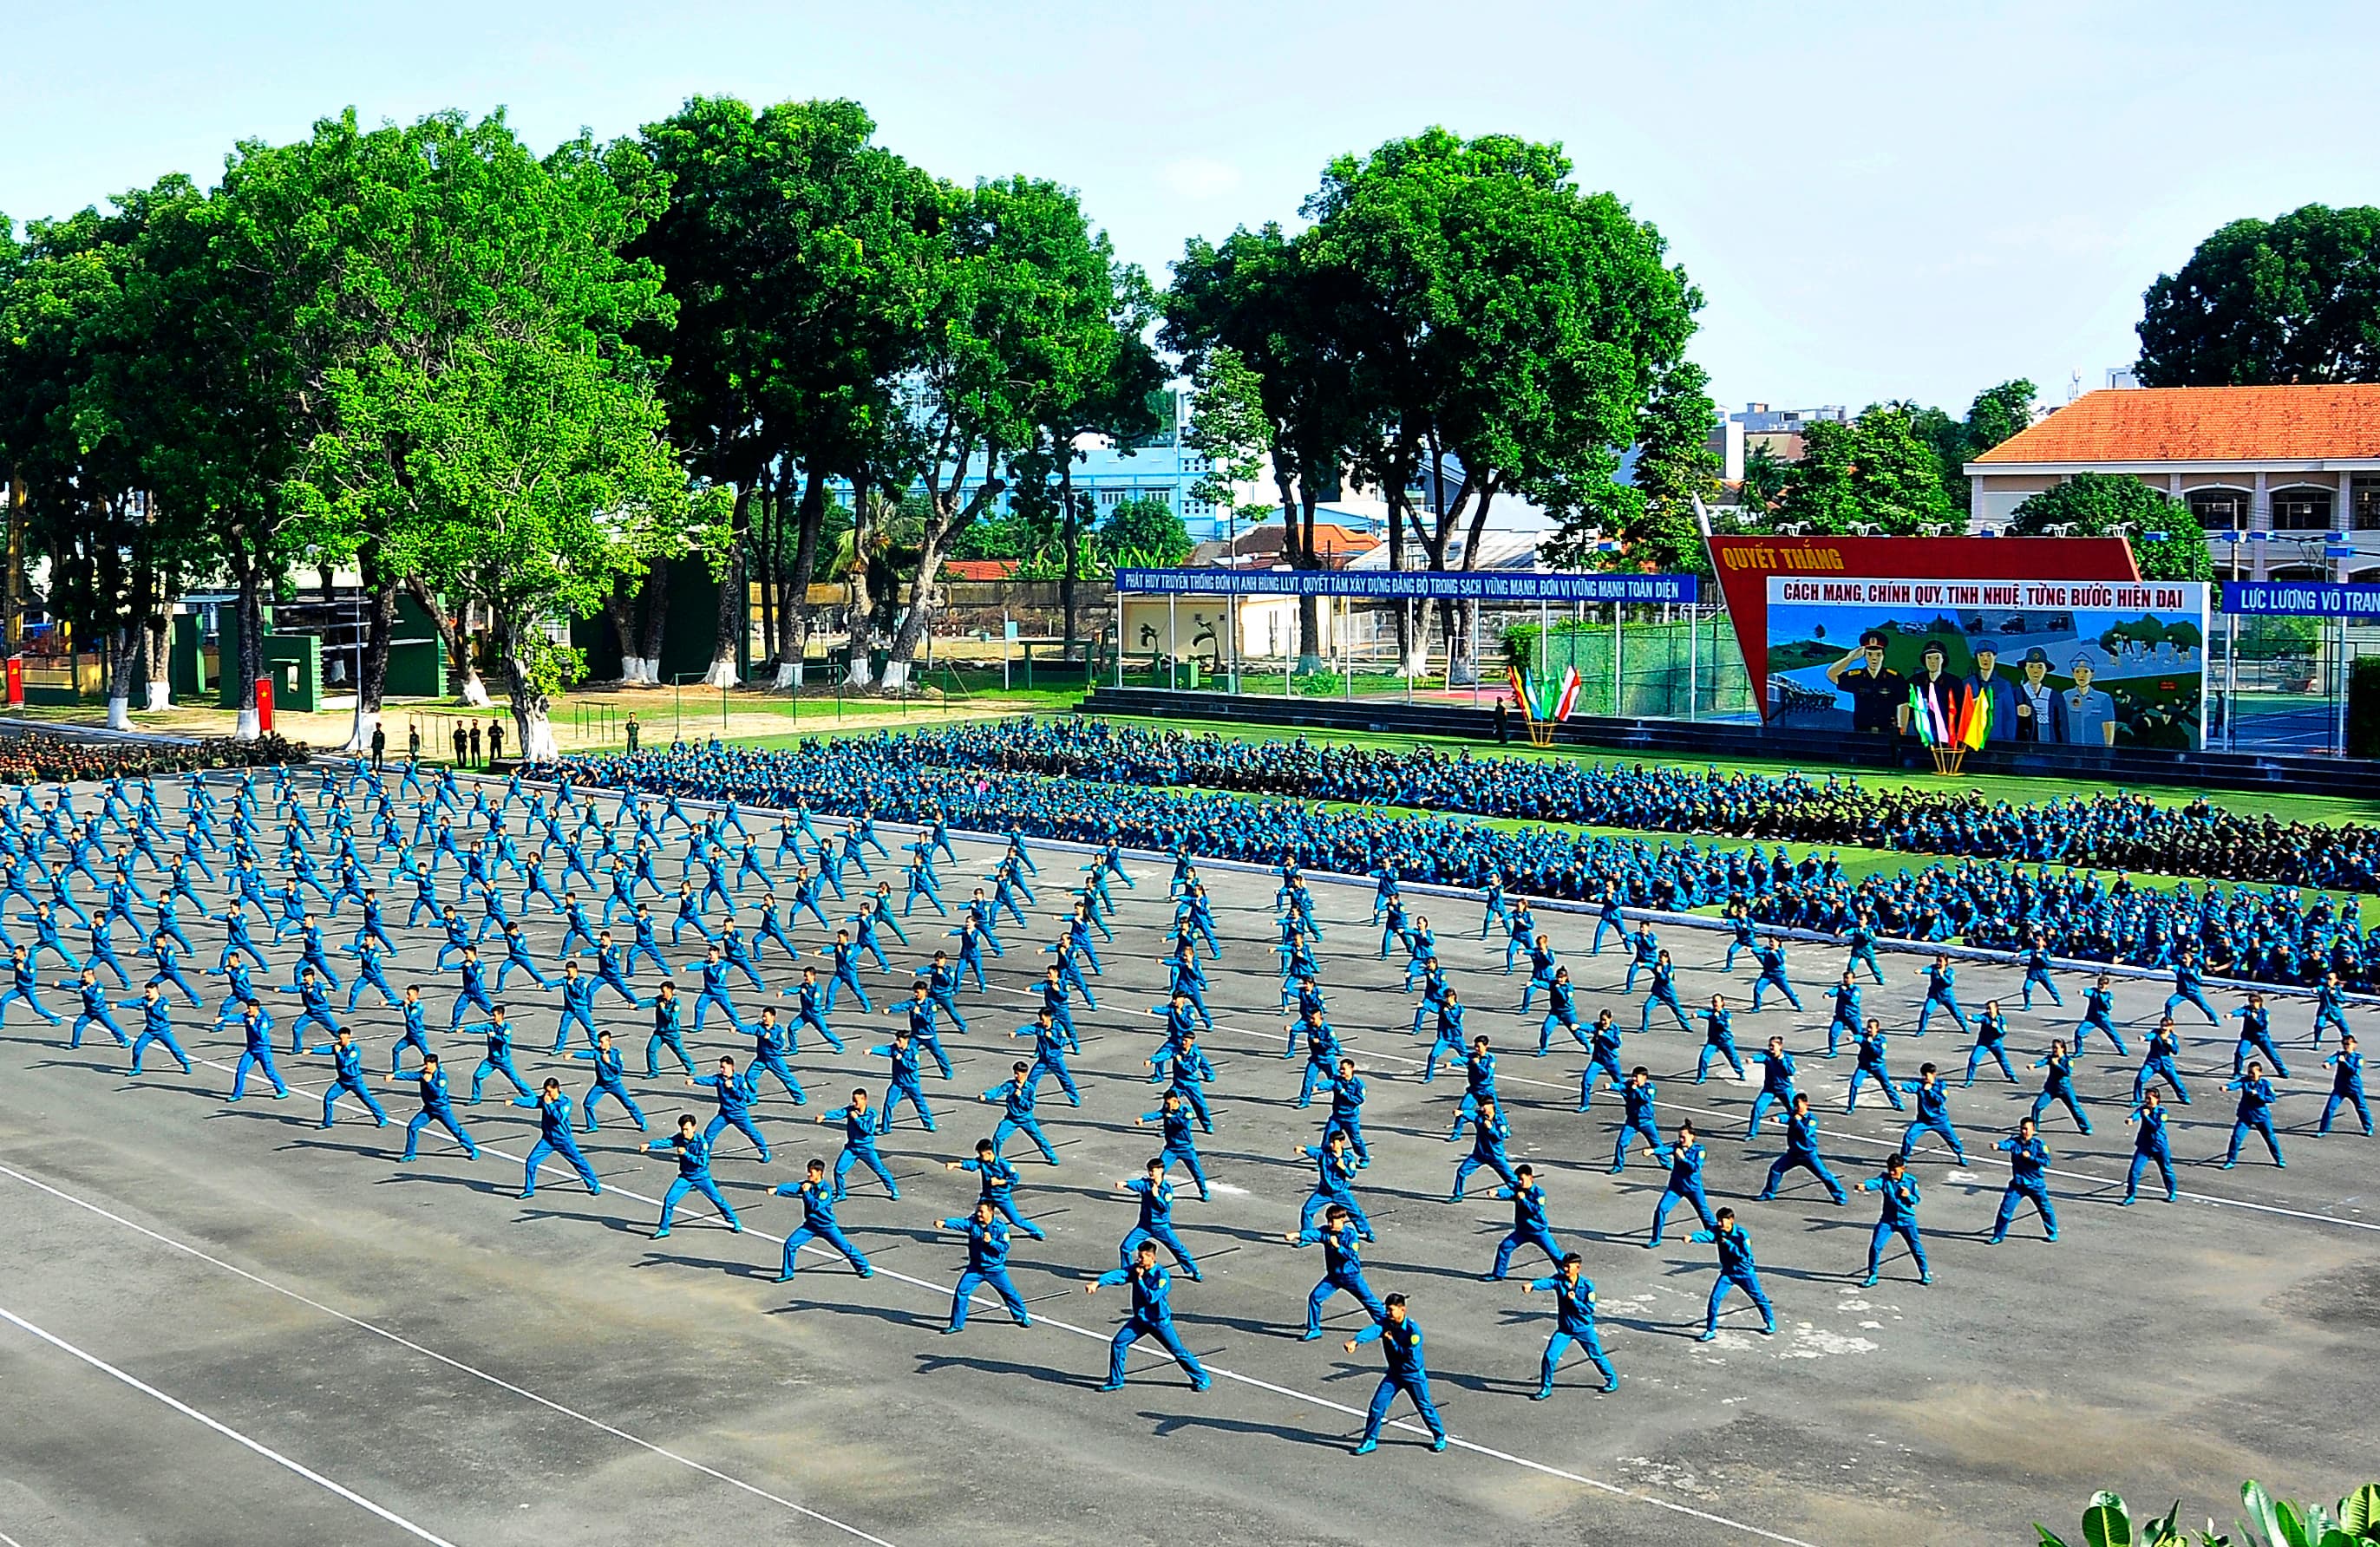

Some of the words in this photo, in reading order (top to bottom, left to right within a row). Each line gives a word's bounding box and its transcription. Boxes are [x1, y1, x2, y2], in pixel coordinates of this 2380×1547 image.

[1722, 542, 1777, 571] QUYẾT
[1779, 539, 1845, 570] THẮNG
[1125, 571, 1143, 589] PHÁT
[1145, 574, 1160, 589] HUY
[1190, 572, 1214, 590] THỐNG
[1232, 576, 1239, 592] VỊ
[1241, 576, 1257, 591] ANH
[1303, 574, 1329, 593] QUYẾT
[1330, 575, 1348, 592] TÂM
[1350, 575, 1366, 592] XÂY
[1392, 574, 1415, 593] ĐẢNG
[1416, 576, 1429, 596] BỘ
[1430, 578, 1457, 593] TRONG
[1460, 579, 1481, 596] SẠCH
[1485, 577, 1508, 594] VỮNG
[1561, 580, 1570, 597] VỊ
[1572, 578, 1596, 597] VỮNG
[1599, 581, 1625, 598] MẠNH
[1627, 578, 1652, 597] TOÀN
[1656, 579, 1679, 600] DIỆN
[1783, 579, 1820, 601] CÁCH
[1823, 584, 1865, 604] MẠNG,
[1868, 581, 1911, 603] CHÍNH
[1914, 585, 1944, 605] QUY,
[1946, 586, 1978, 604] TINH
[1984, 584, 2024, 609] NHUỆ,
[2026, 583, 2066, 606] TỪNG
[2071, 583, 2113, 607] BƯỚC
[2117, 585, 2151, 611] HIỆN
[2156, 589, 2183, 612] ĐẠI
[2241, 587, 2266, 611] LỰC
[2271, 589, 2317, 612] LƯỢNG
